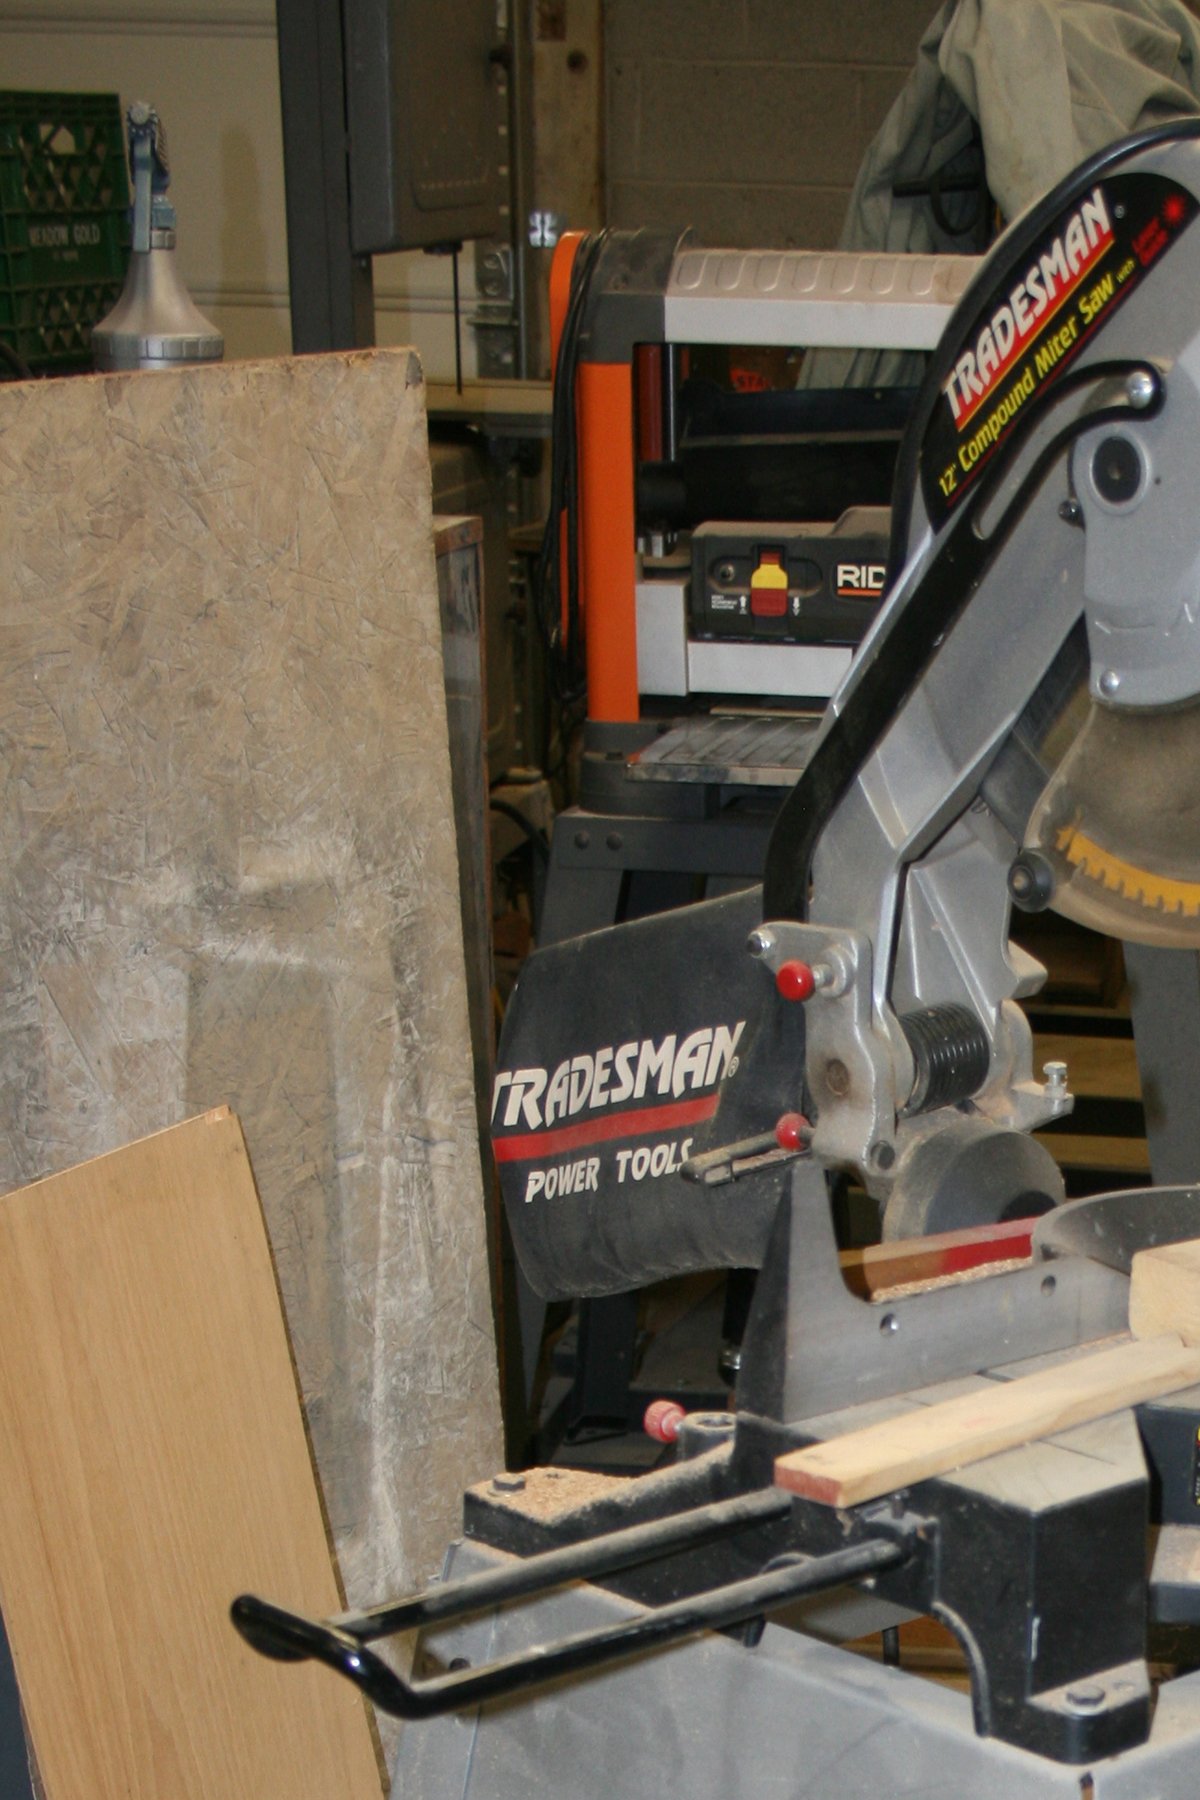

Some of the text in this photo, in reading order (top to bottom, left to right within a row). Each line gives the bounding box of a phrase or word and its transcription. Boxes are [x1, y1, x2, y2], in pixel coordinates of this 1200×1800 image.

[941, 185, 1112, 421] TRADESMAN
[957, 367, 1036, 473] Compound
[1034, 316, 1080, 381] Miter
[1078, 271, 1115, 325] Saw
[490, 1021, 747, 1130] TRADESMAN
[525, 1137, 694, 1204] POWER TOOLS
